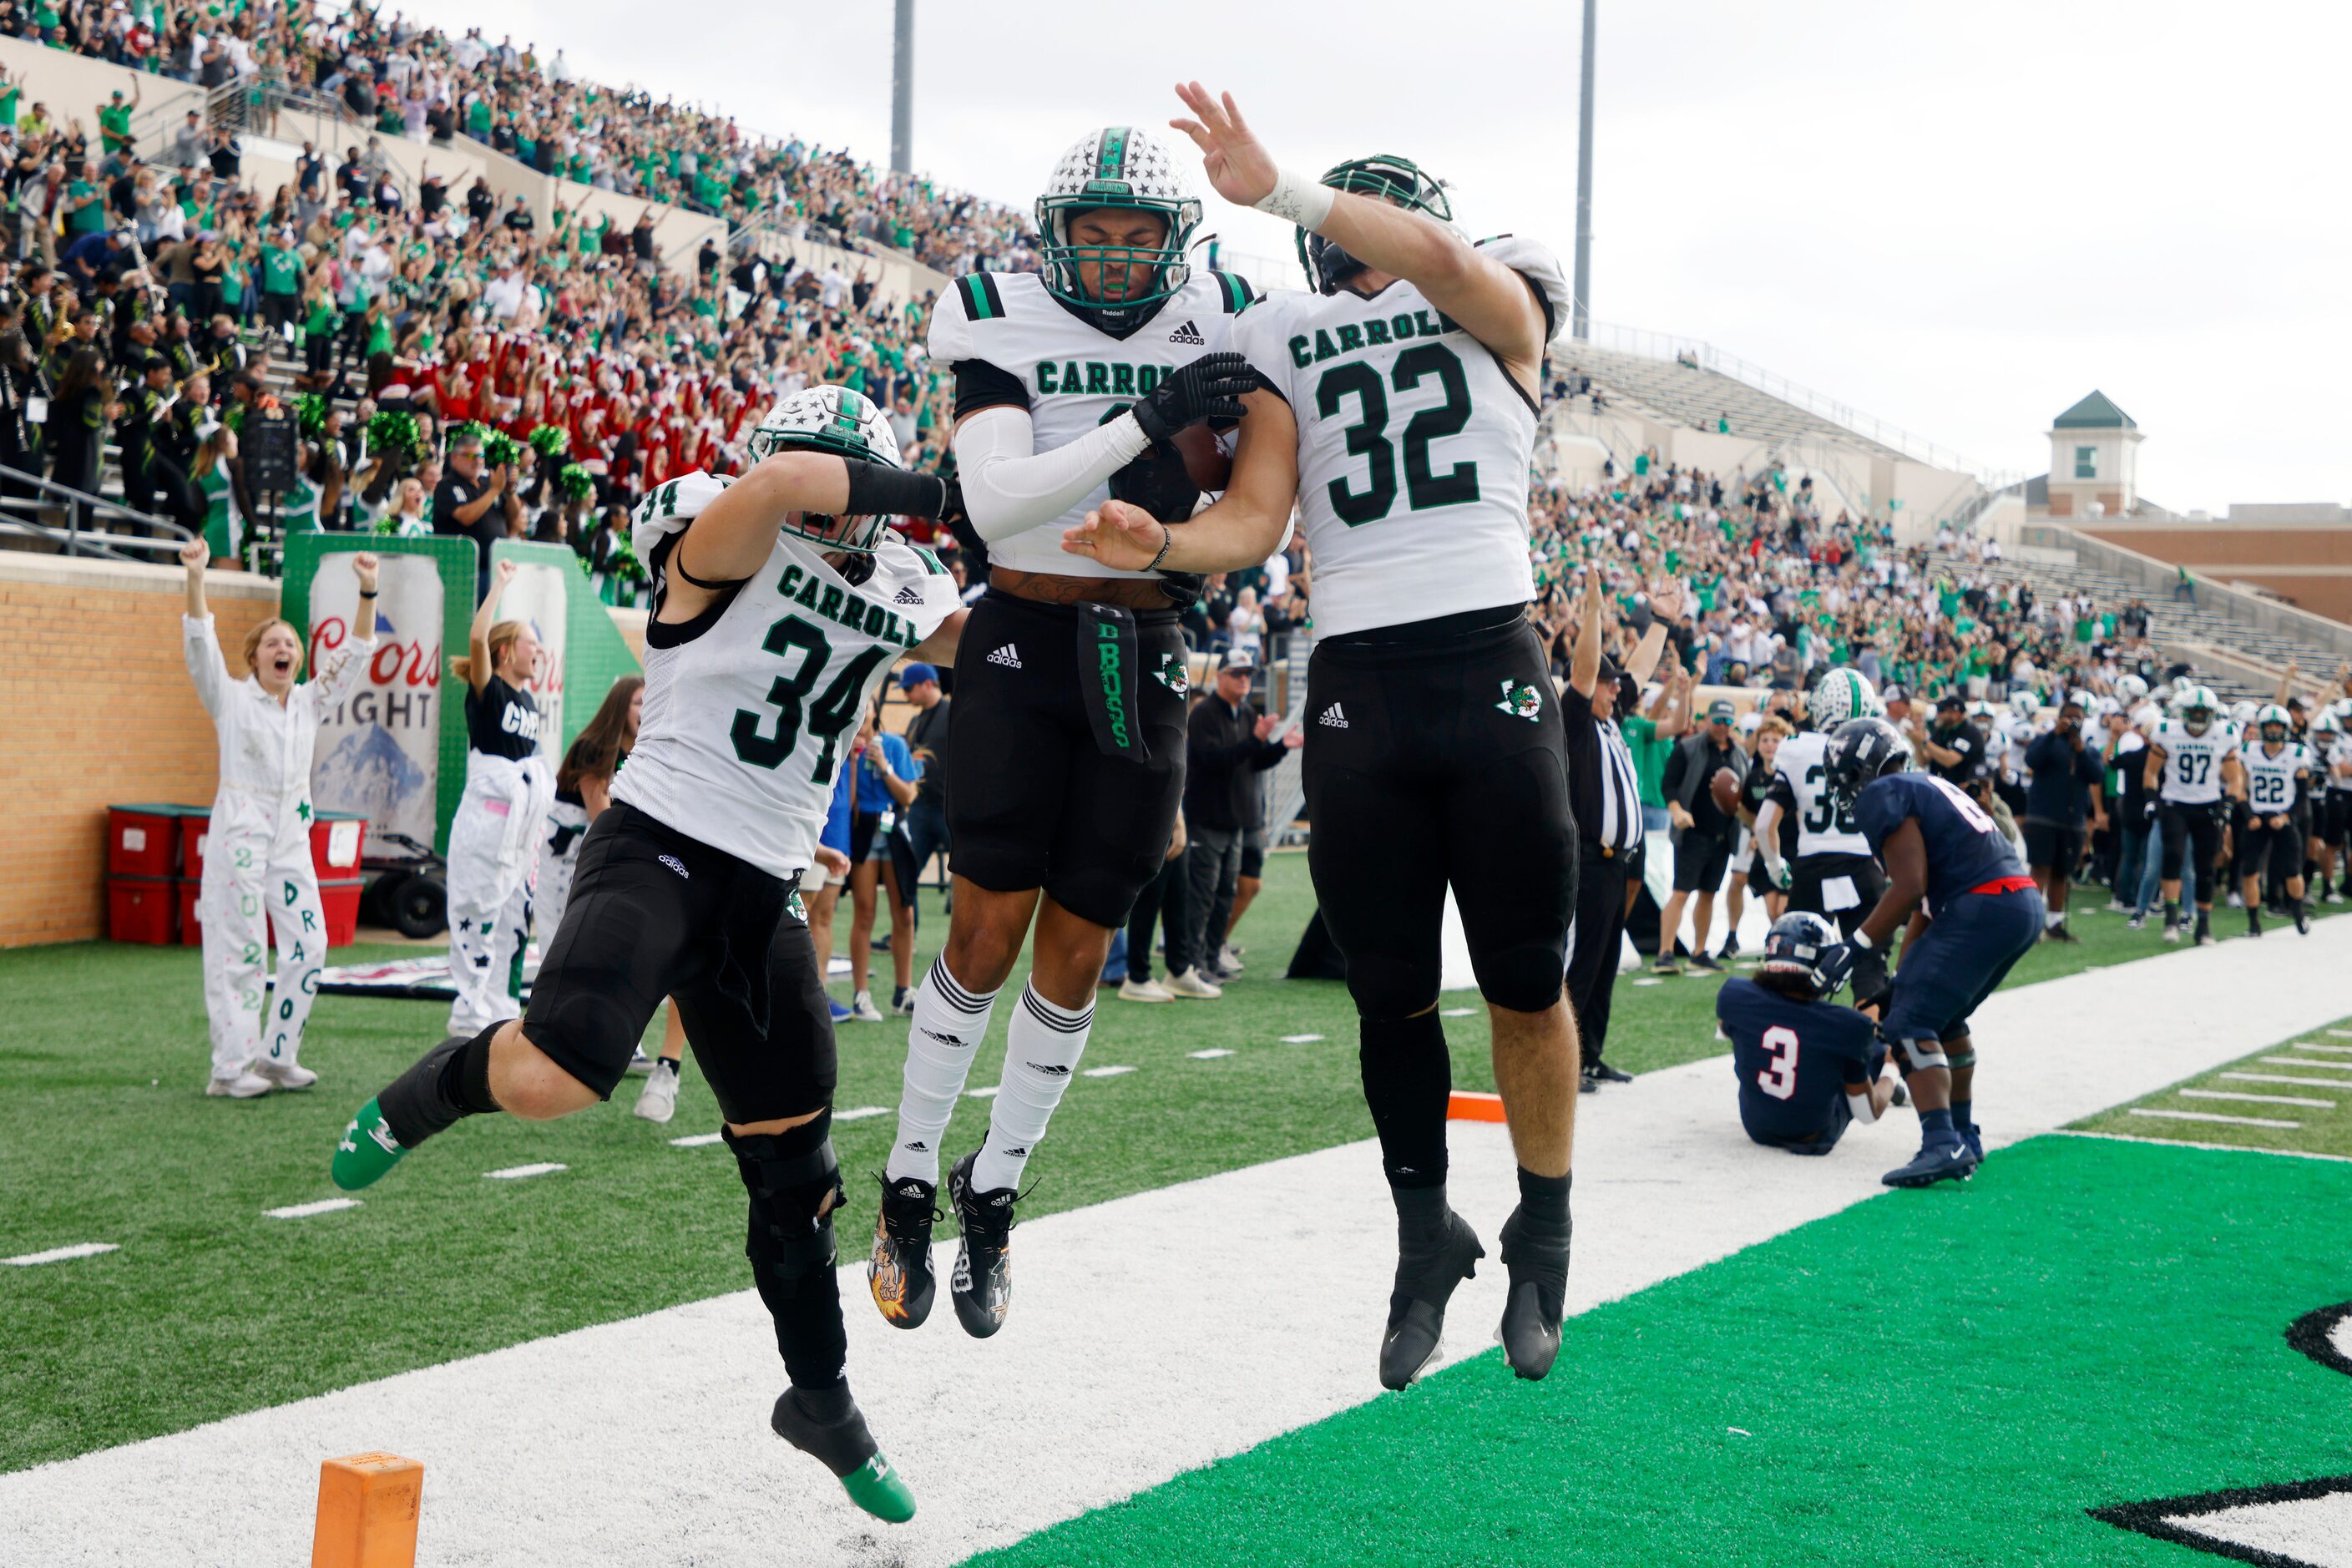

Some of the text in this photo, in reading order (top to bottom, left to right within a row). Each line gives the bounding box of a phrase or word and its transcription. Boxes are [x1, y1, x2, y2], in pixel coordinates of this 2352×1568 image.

[1086, 180, 1130, 195] DRAGONS
[1169, 334, 1205, 346] adidas
[1036, 361, 1174, 398] CARRO
[1315, 341, 1481, 528] 32
[640, 480, 683, 525] 34
[776, 564, 923, 650] CARROLL
[893, 596, 924, 605] adidas
[309, 616, 441, 687] Cors
[986, 653, 1023, 669] adidas
[322, 691, 432, 727] IGHT
[730, 614, 892, 786] 34
[1318, 716, 1349, 729] adidas
[2178, 753, 2211, 785] 97
[2253, 776, 2284, 803] 22
[658, 854, 690, 879] adidas
[271, 881, 322, 1059] DRAGOS
[1758, 1024, 1800, 1102] 3
[904, 1145, 929, 1153] adidas
[1003, 1150, 1028, 1158] adidas
[899, 1189, 925, 1199] adidas
